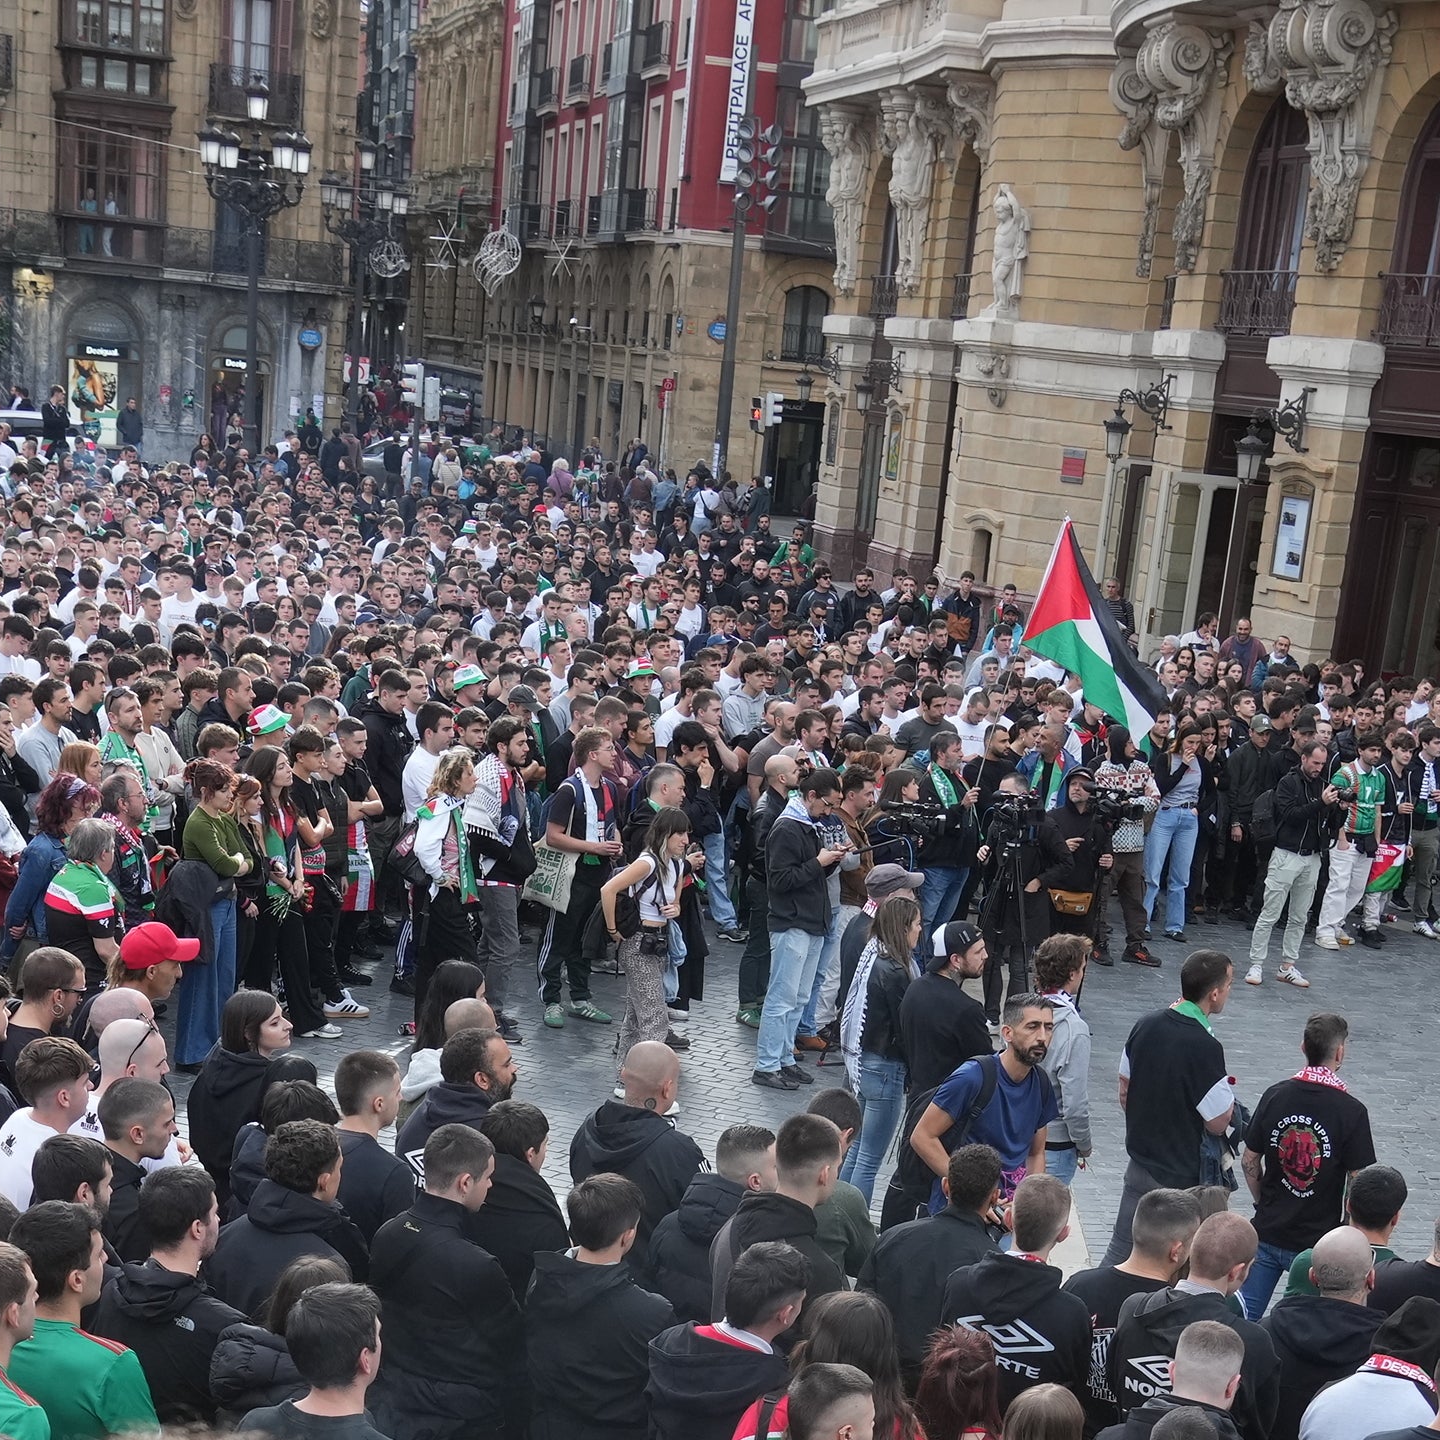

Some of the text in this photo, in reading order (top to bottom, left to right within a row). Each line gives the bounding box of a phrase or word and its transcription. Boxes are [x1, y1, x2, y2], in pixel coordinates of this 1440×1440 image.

[725, 34, 750, 161] PETITPALACE
[225, 358, 247, 370] Desig
[1364, 786, 1372, 800] 7
[1270, 1114, 1331, 1158] JAB CROSS UPPER
[994, 1354, 1041, 1379] RTE
